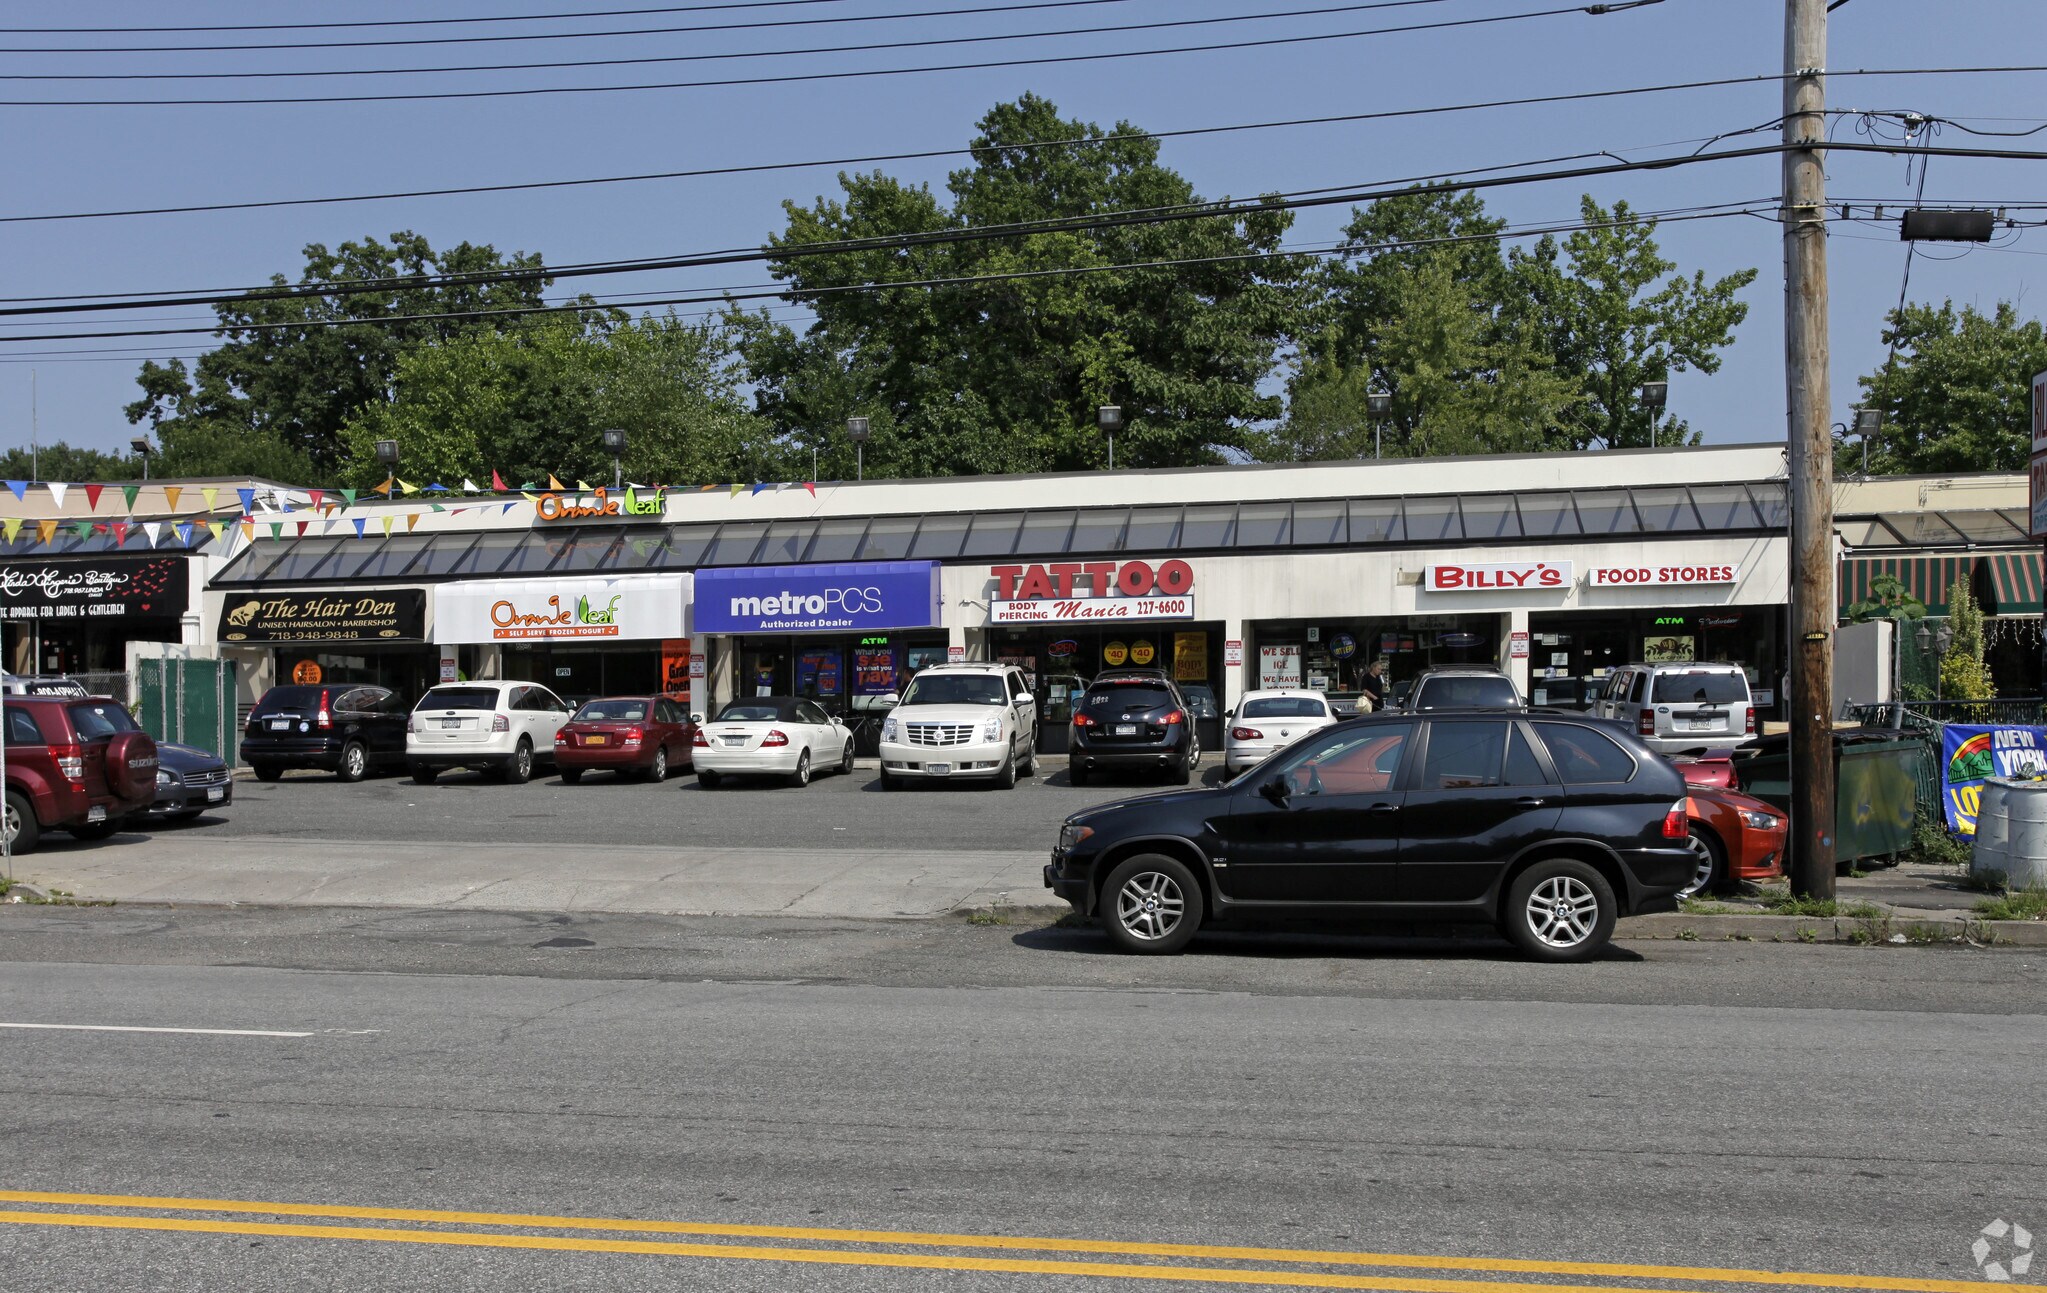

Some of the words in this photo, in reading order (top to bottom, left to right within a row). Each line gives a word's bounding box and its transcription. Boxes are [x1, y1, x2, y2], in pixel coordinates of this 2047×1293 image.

[536, 487, 620, 520] Orange
[991, 560, 1194, 600] TATTOO
[1434, 564, 1562, 588] BILLY'S
[1597, 568, 1652, 584] FOOD
[1658, 566, 1733, 582] STORES
[10, 606, 38, 618] APPAREL
[40, 606, 54, 617] FOR
[56, 605, 77, 616] LADIES
[80, 605, 86, 616] &
[88, 604, 125, 616] GENTLEMEN
[262, 598, 298, 618] The
[301, 598, 352, 618] Hair
[354, 598, 396, 616] Den
[490, 595, 571, 627] Orange
[1008, 602, 1038, 611] BODY
[1053, 600, 1129, 619] Mania
[1137, 600, 1185, 615] 227-6600
[999, 611, 1048, 620] PIERCING
[258, 620, 287, 629] UNISEX
[289, 620, 337, 628] HAIRSALON
[342, 619, 397, 627] BARBERSHOP
[760, 619, 816, 628] Authorized
[818, 618, 853, 627] Dealer
[268, 631, 358, 640] 718-948-9848
[1310, 629, 1317, 638] B
[1048, 642, 1077, 655] OPEN
[1262, 648, 1276, 656] WE
[1280, 647, 1300, 656] SELL
[858, 655, 891, 666] see
[1273, 661, 1288, 669] ICE
[1994, 730, 2035, 748] NEW
